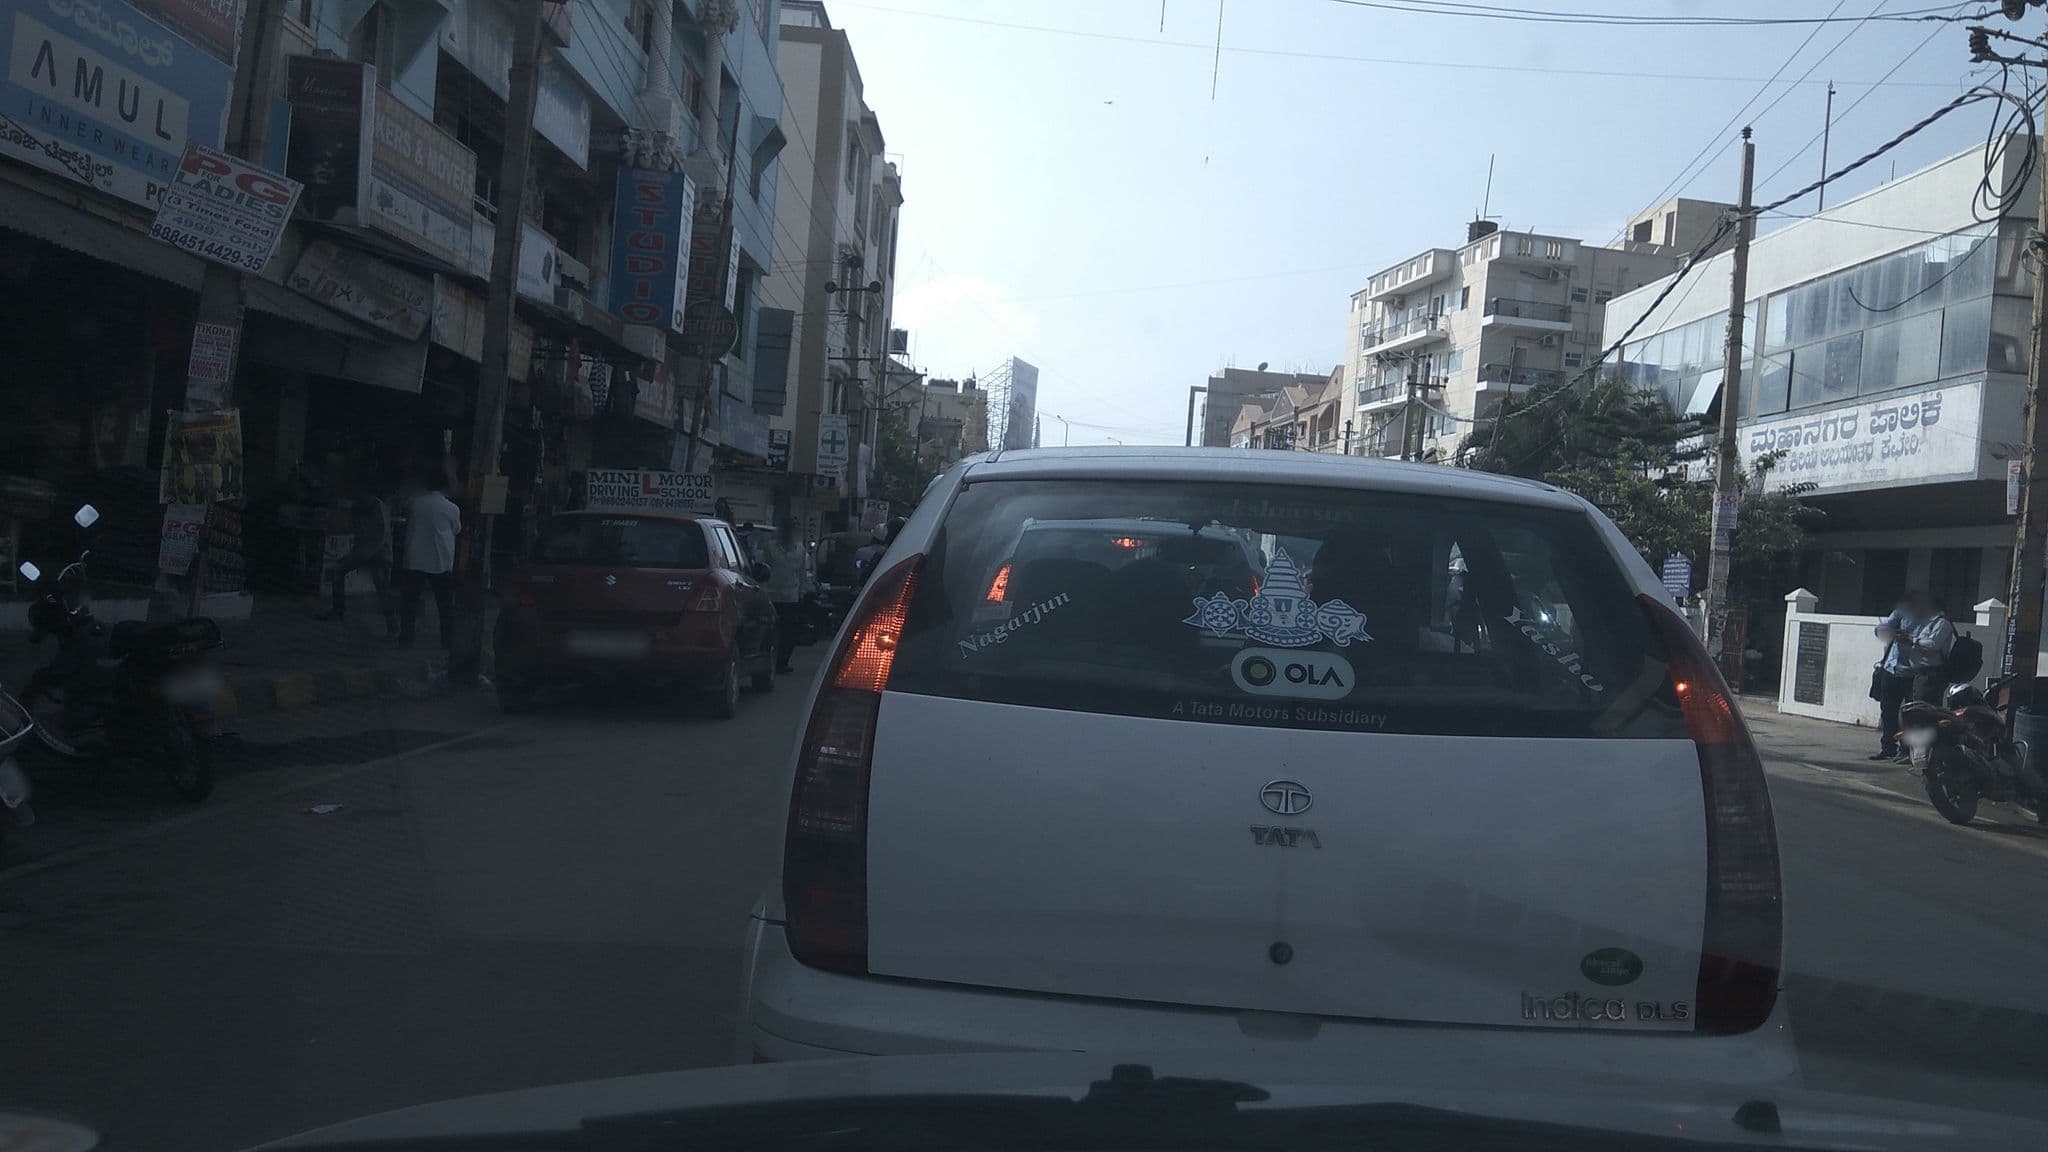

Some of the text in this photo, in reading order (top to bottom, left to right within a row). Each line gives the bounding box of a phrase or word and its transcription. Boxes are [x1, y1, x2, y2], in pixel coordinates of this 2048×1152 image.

[31, 39, 172, 142] AMUL
[26, 99, 104, 146] INNER
[113, 136, 170, 171] WEAR
[180, 150, 291, 206] PG
[201, 169, 222, 184] FOR
[174, 170, 285, 219] LADIES
[186, 200, 231, 223] Times
[234, 219, 275, 239] Food)
[230, 234, 267, 254] Only
[620, 183, 673, 324] STUDIO
[1750, 391, 1943, 454] ಮಹಾನಗರ ಪಾಲಿಕೆ
[589, 471, 713, 496] MINI L MOTOR
[589, 484, 712, 500] DRIVING SCHOOL
[958, 591, 1071, 659] Nagarjun
[1284, 663, 1345, 687] OLA
[1172, 701, 1388, 728] A Tata Motors Subsidiary
[1250, 824, 1322, 849] TATA
[1637, 1001, 1690, 1021] DLS
